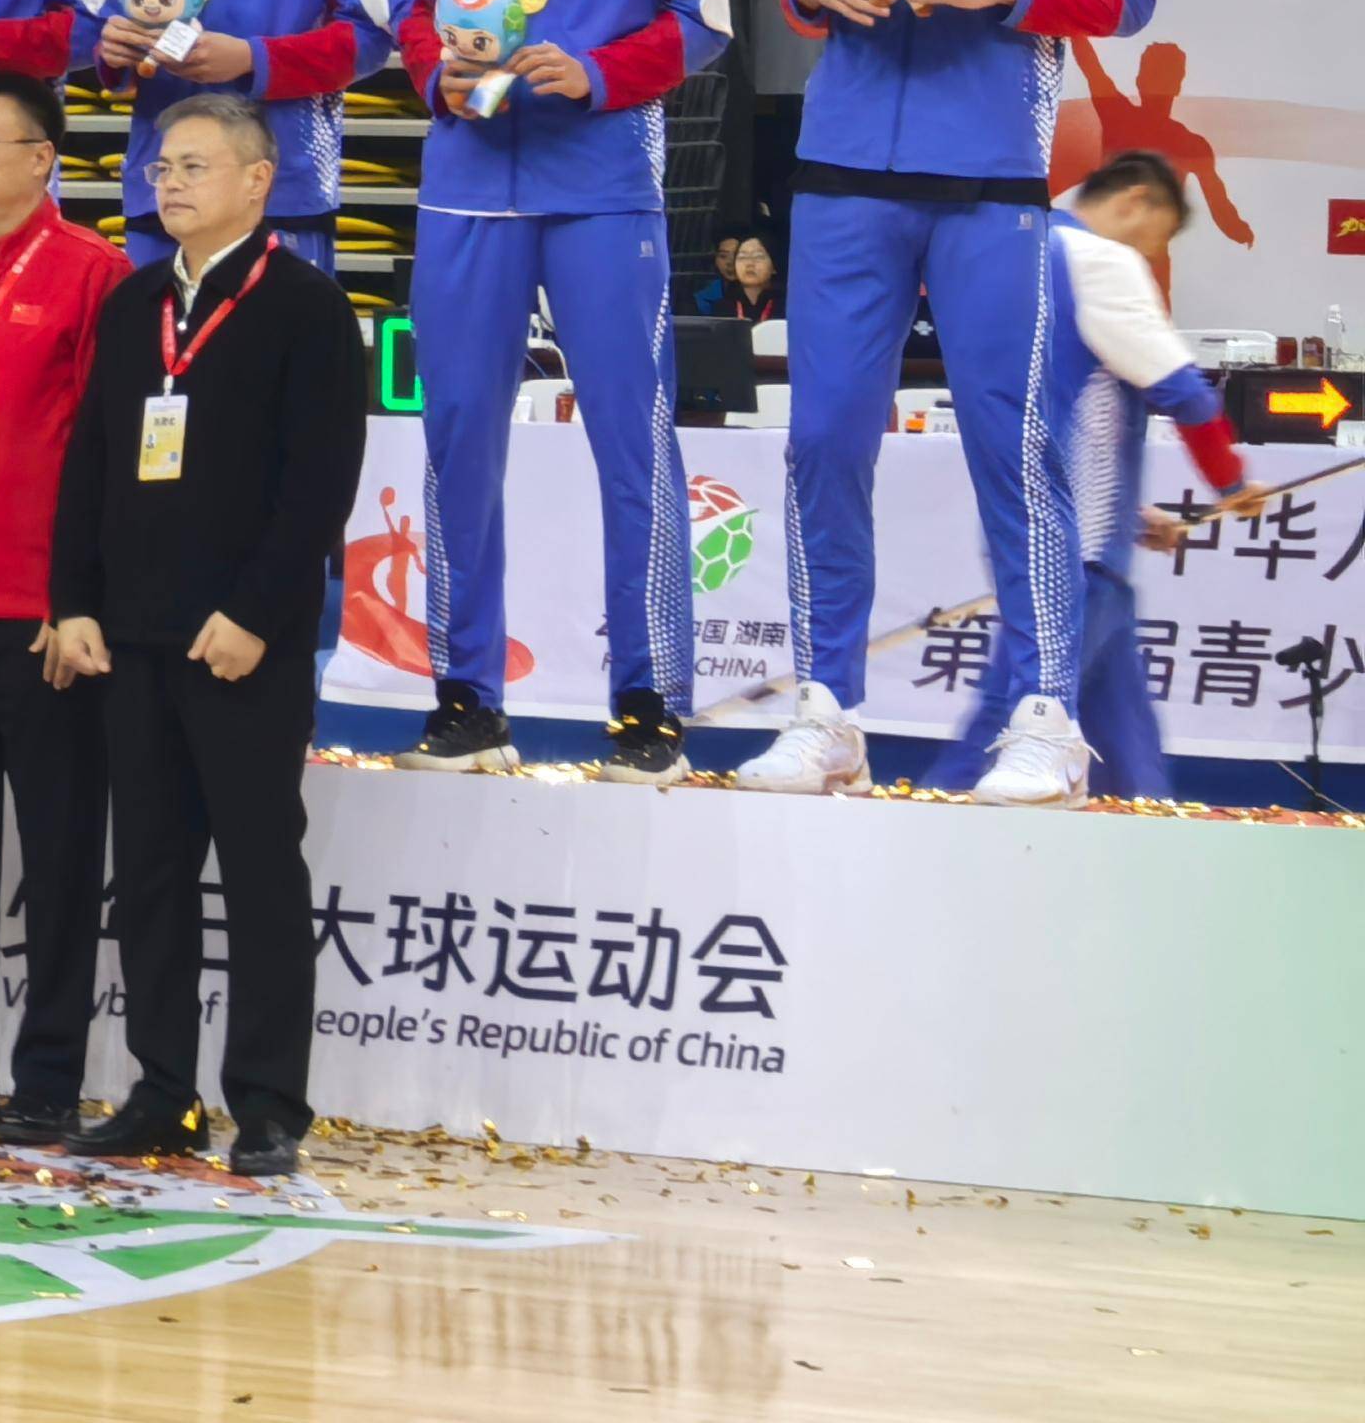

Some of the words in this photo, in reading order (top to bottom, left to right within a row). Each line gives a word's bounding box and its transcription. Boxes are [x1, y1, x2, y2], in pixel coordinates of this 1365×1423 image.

[694, 655, 767, 678] CHINA
[315, 1006, 445, 1047] eople's
[457, 1013, 618, 1059] Republic
[628, 1027, 672, 1064] of
[677, 1032, 786, 1074] China
